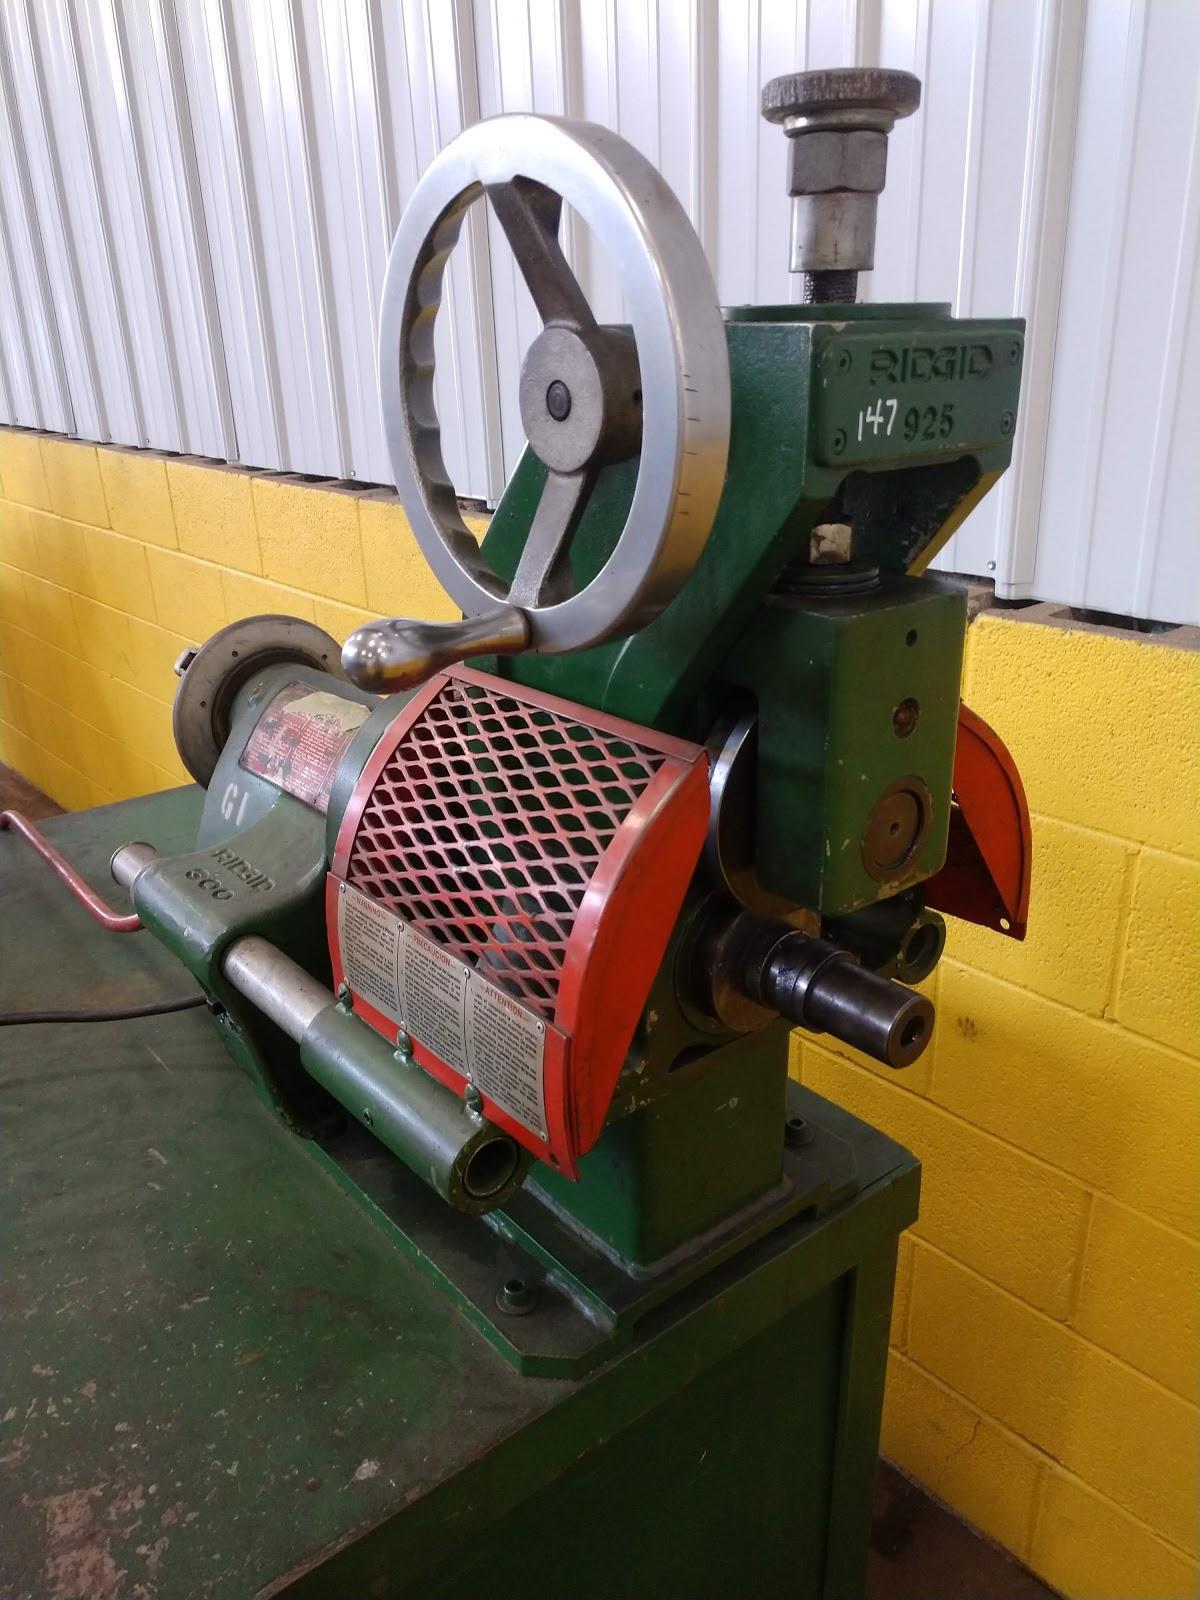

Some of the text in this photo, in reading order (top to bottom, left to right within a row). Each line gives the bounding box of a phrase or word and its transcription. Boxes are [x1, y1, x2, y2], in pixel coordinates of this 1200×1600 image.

[870, 345, 993, 385] RIDGID
[857, 398, 898, 442] 147
[903, 404, 954, 442] 925
[485, 985, 523, 1019] ATTENTION
